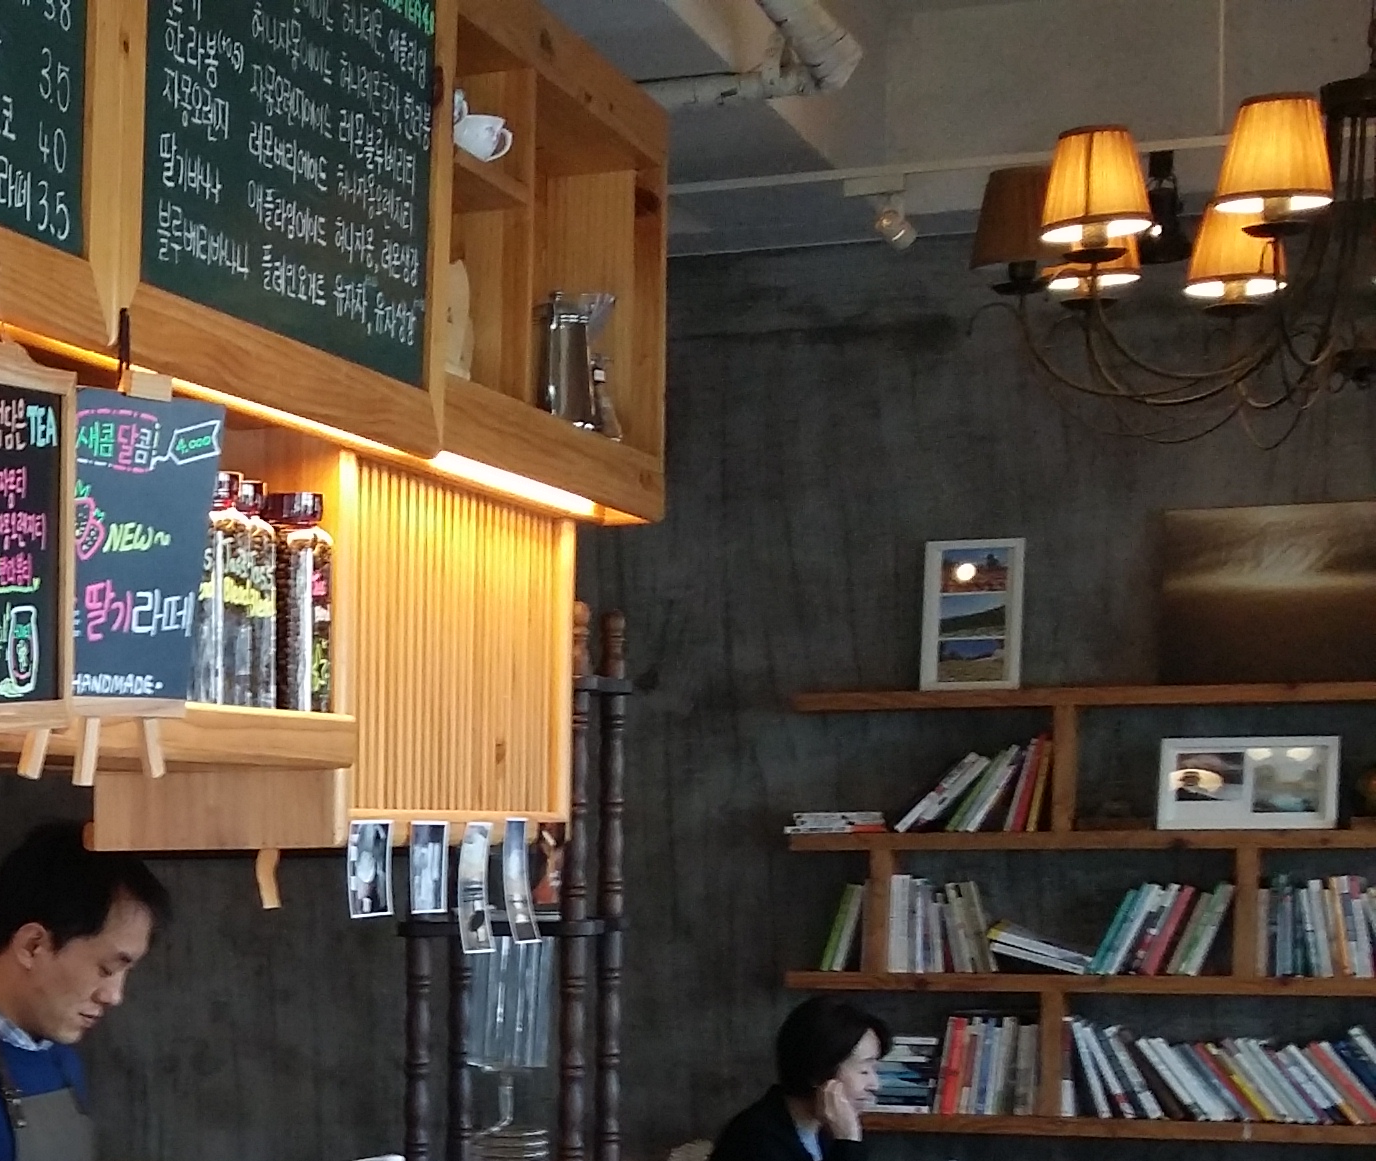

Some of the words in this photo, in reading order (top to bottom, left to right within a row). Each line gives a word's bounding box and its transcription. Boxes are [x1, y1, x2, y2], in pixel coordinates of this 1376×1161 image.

[39, 47, 71, 113] 3.5
[164, 9, 219, 89] 한라봉
[162, 67, 230, 142] 자몽오렌지
[159, 132, 223, 204] 딸기바나나
[37, 180, 71, 241] 3.5
[156, 199, 250, 281] 블루베리바나나
[26, 404, 58, 448] TEA
[85, 578, 197, 643] 딸기라떼
